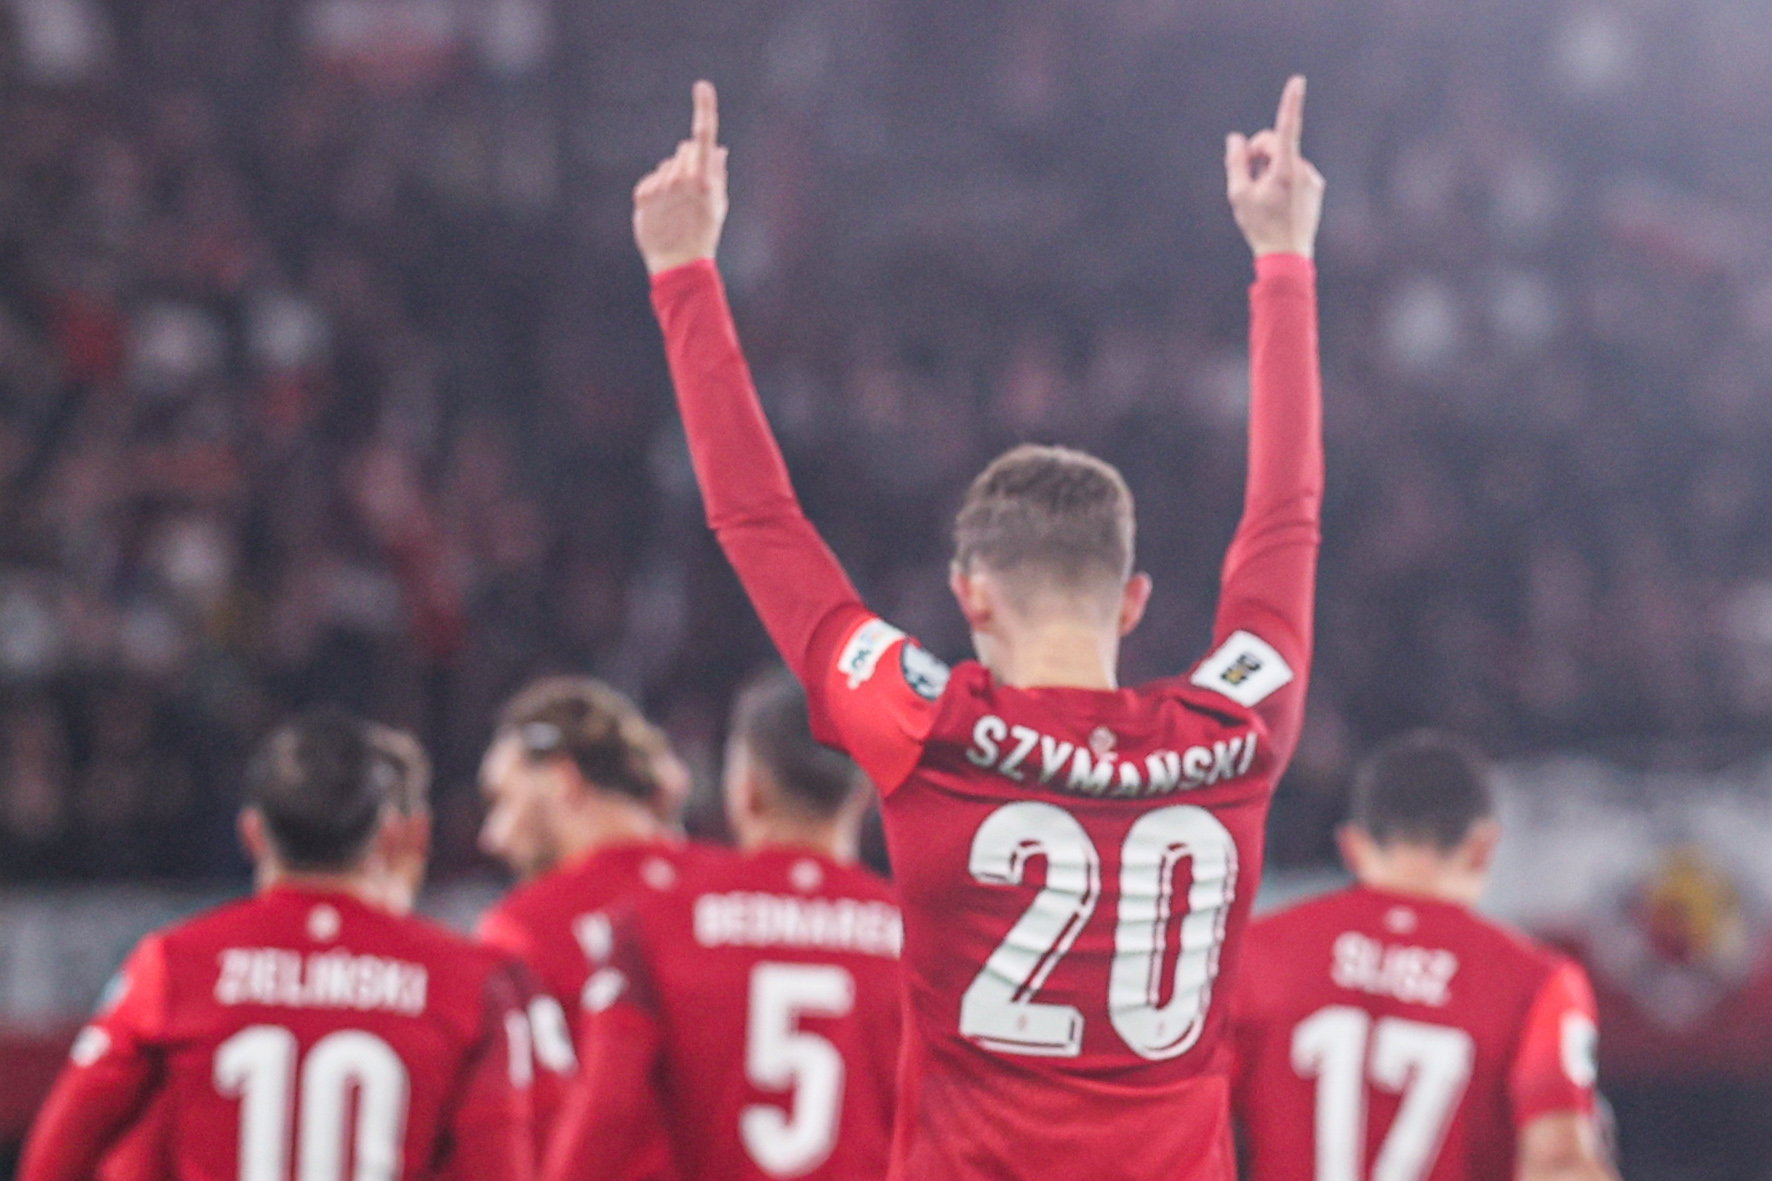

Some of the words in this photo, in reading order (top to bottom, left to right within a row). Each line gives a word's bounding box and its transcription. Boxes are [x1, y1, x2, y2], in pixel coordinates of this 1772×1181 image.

[959, 801, 1239, 1061] 20
[1330, 930, 1460, 1007] SLISZ
[741, 962, 855, 1177] 5
